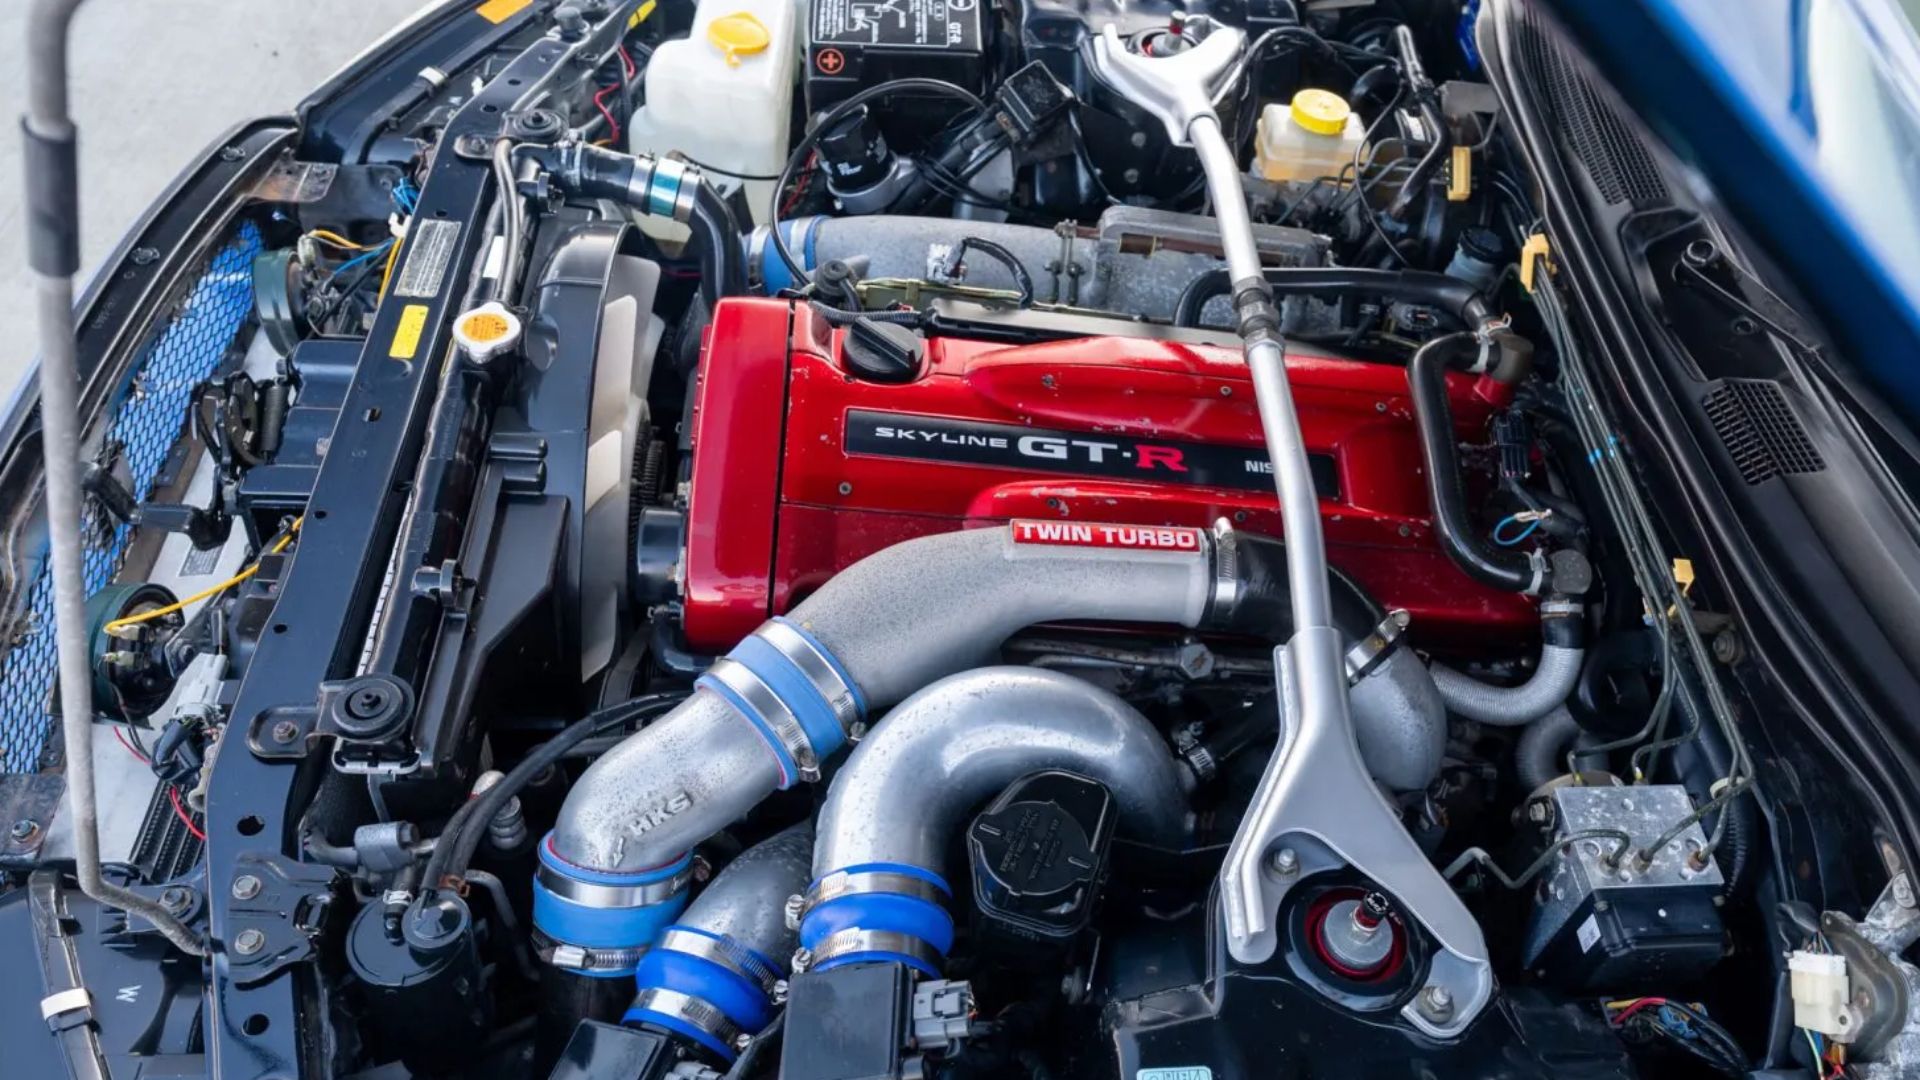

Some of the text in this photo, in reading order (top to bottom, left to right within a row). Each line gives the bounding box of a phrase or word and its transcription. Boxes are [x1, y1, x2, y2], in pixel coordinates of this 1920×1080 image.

[875, 426, 1008, 448] SKYLINE
[1244, 459, 1275, 474] NIS
[1018, 522, 1196, 548] TWIN TURBO
[628, 791, 695, 837] HKS
